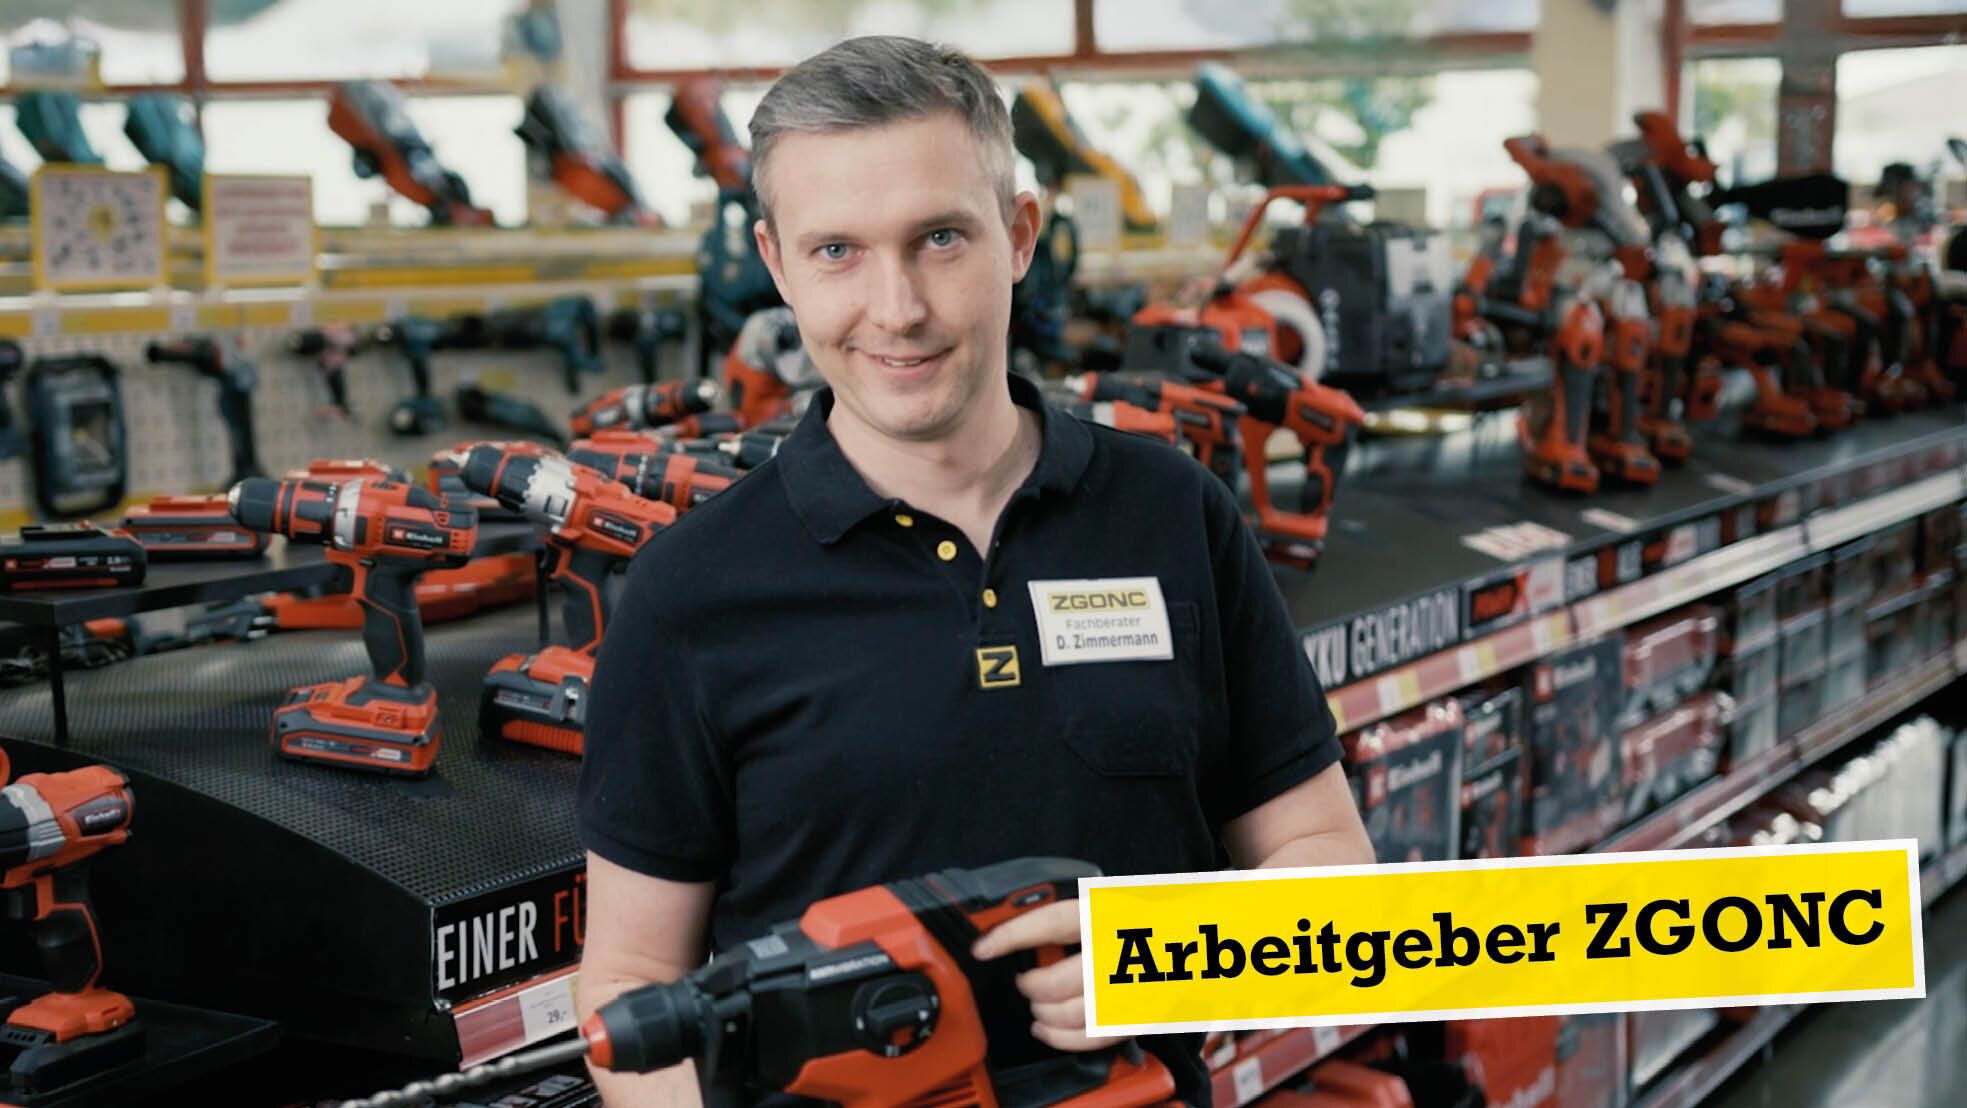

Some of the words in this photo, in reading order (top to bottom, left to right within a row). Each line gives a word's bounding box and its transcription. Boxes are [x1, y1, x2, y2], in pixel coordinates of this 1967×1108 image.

[1052, 591, 1147, 611] ZGONC
[1066, 616, 1141, 631] Fachberater
[1056, 634, 1070, 651] D.
[1074, 632, 1159, 650] Zimmermann
[1303, 624, 1347, 689] KKU
[1351, 587, 1459, 677] GENERATION
[981, 650, 1016, 683] Z
[437, 901, 540, 992] EINER
[554, 872, 587, 952] FÜ
